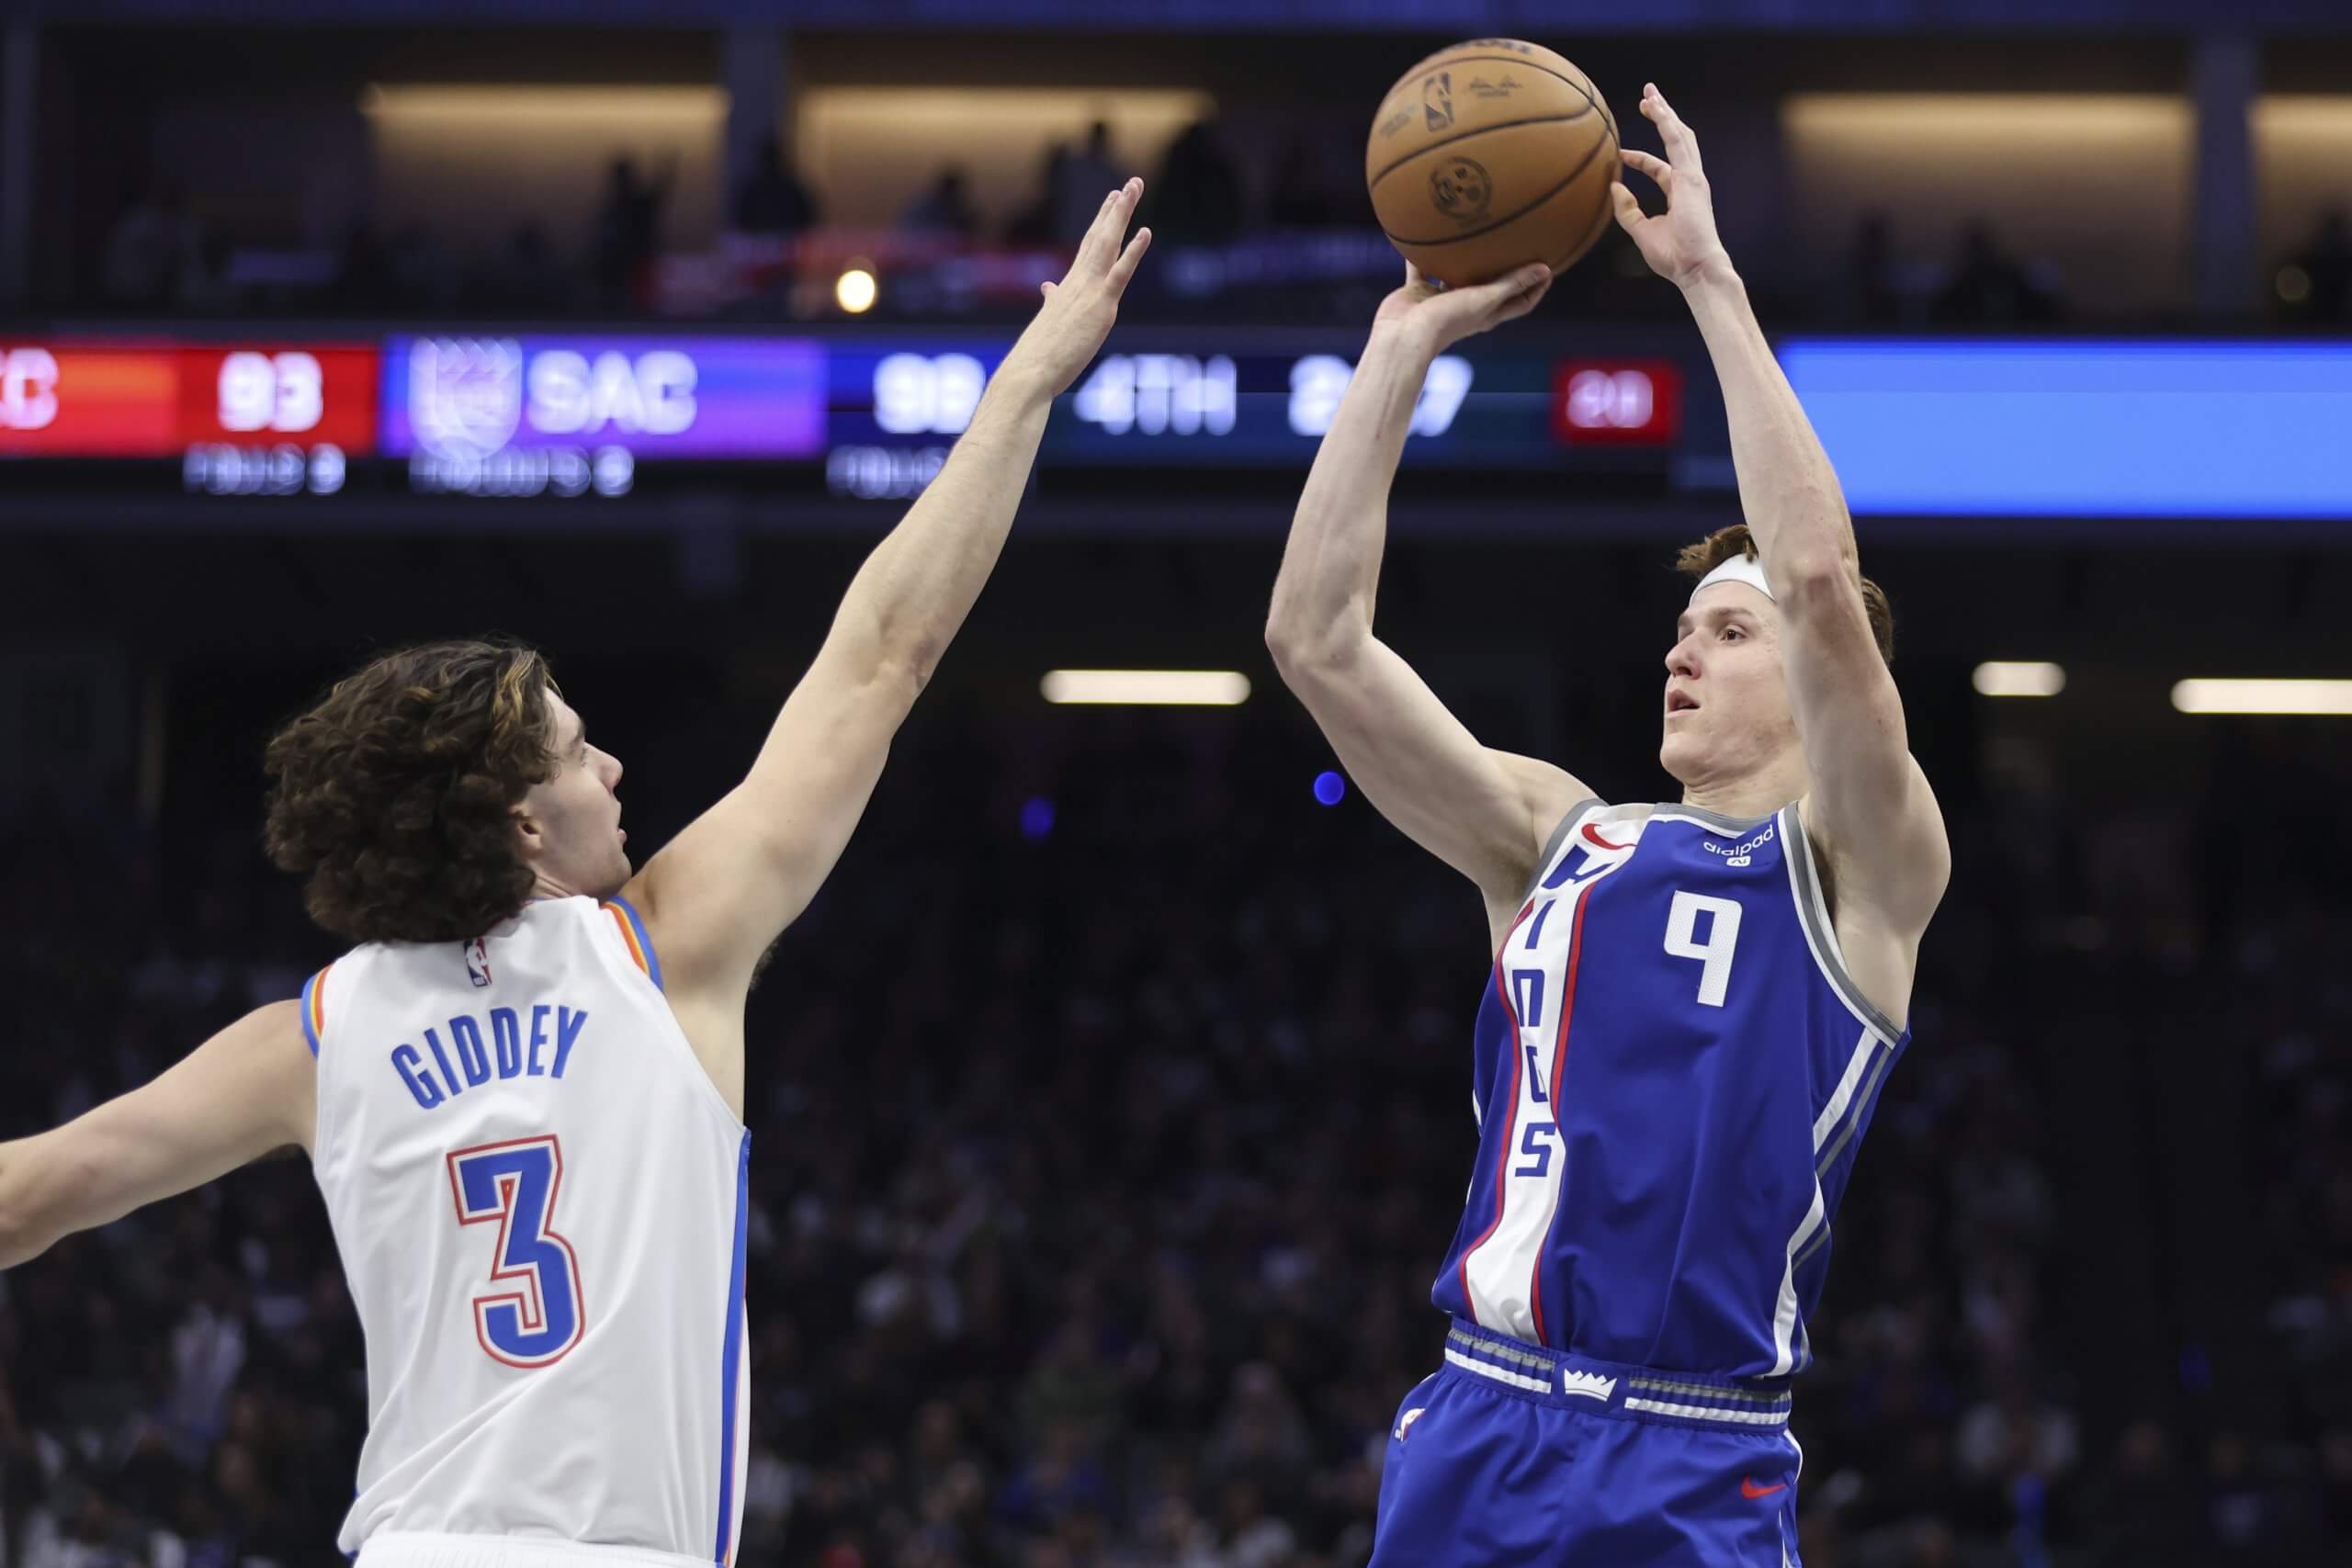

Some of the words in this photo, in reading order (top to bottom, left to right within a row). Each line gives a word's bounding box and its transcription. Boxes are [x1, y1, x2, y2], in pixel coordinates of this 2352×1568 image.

[0, 347, 59, 430] C
[527, 350, 697, 434] SAC
[1073, 354, 1236, 435] 4TH
[1664, 889, 1743, 1007] 9
[391, 1005, 588, 1110] GIDDEY
[447, 1134, 586, 1369] 3
